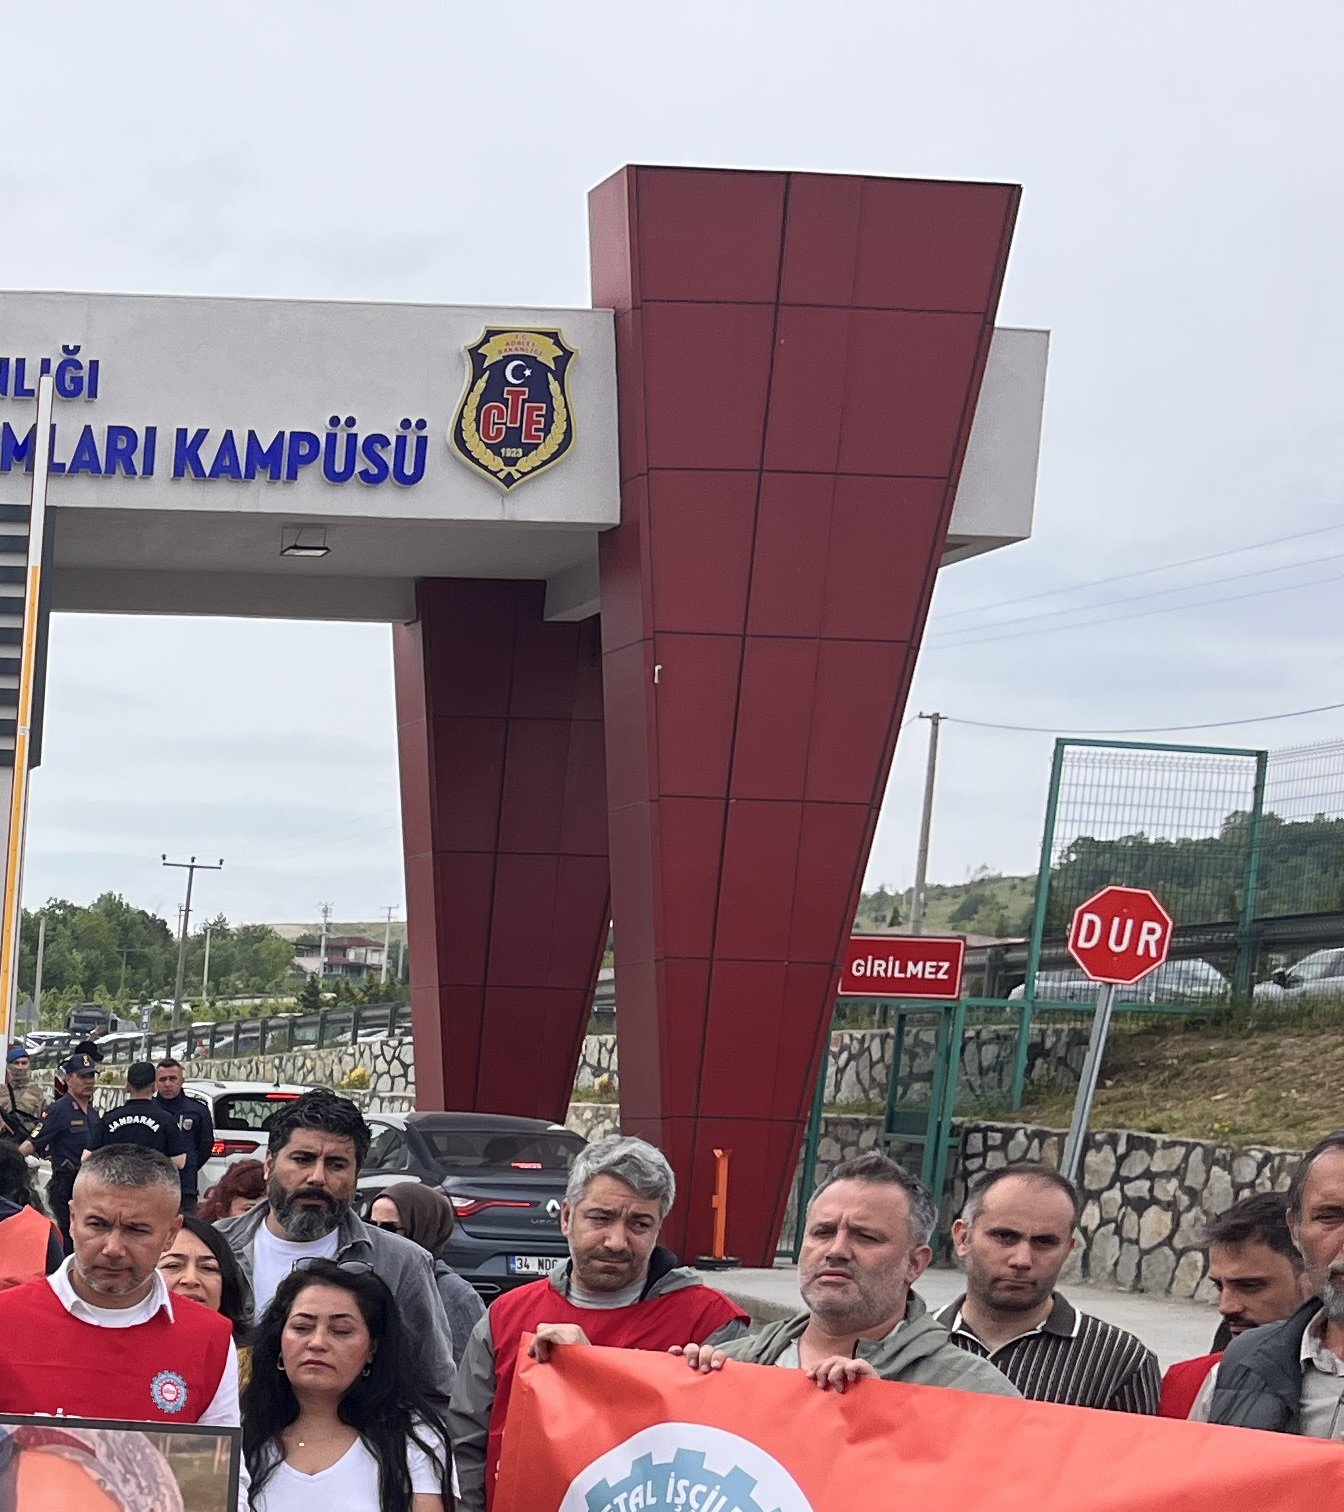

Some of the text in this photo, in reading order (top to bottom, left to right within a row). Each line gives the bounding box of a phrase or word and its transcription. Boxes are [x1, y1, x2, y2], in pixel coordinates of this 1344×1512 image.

[480, 387, 546, 443] CTE
[174, 415, 429, 487] KAMPÜSÜ
[1076, 912, 1162, 958] DUR
[851, 955, 951, 981] GİRİLMEZ
[108, 1114, 161, 1133] JANDARMA
[516, 1257, 530, 1270] 34
